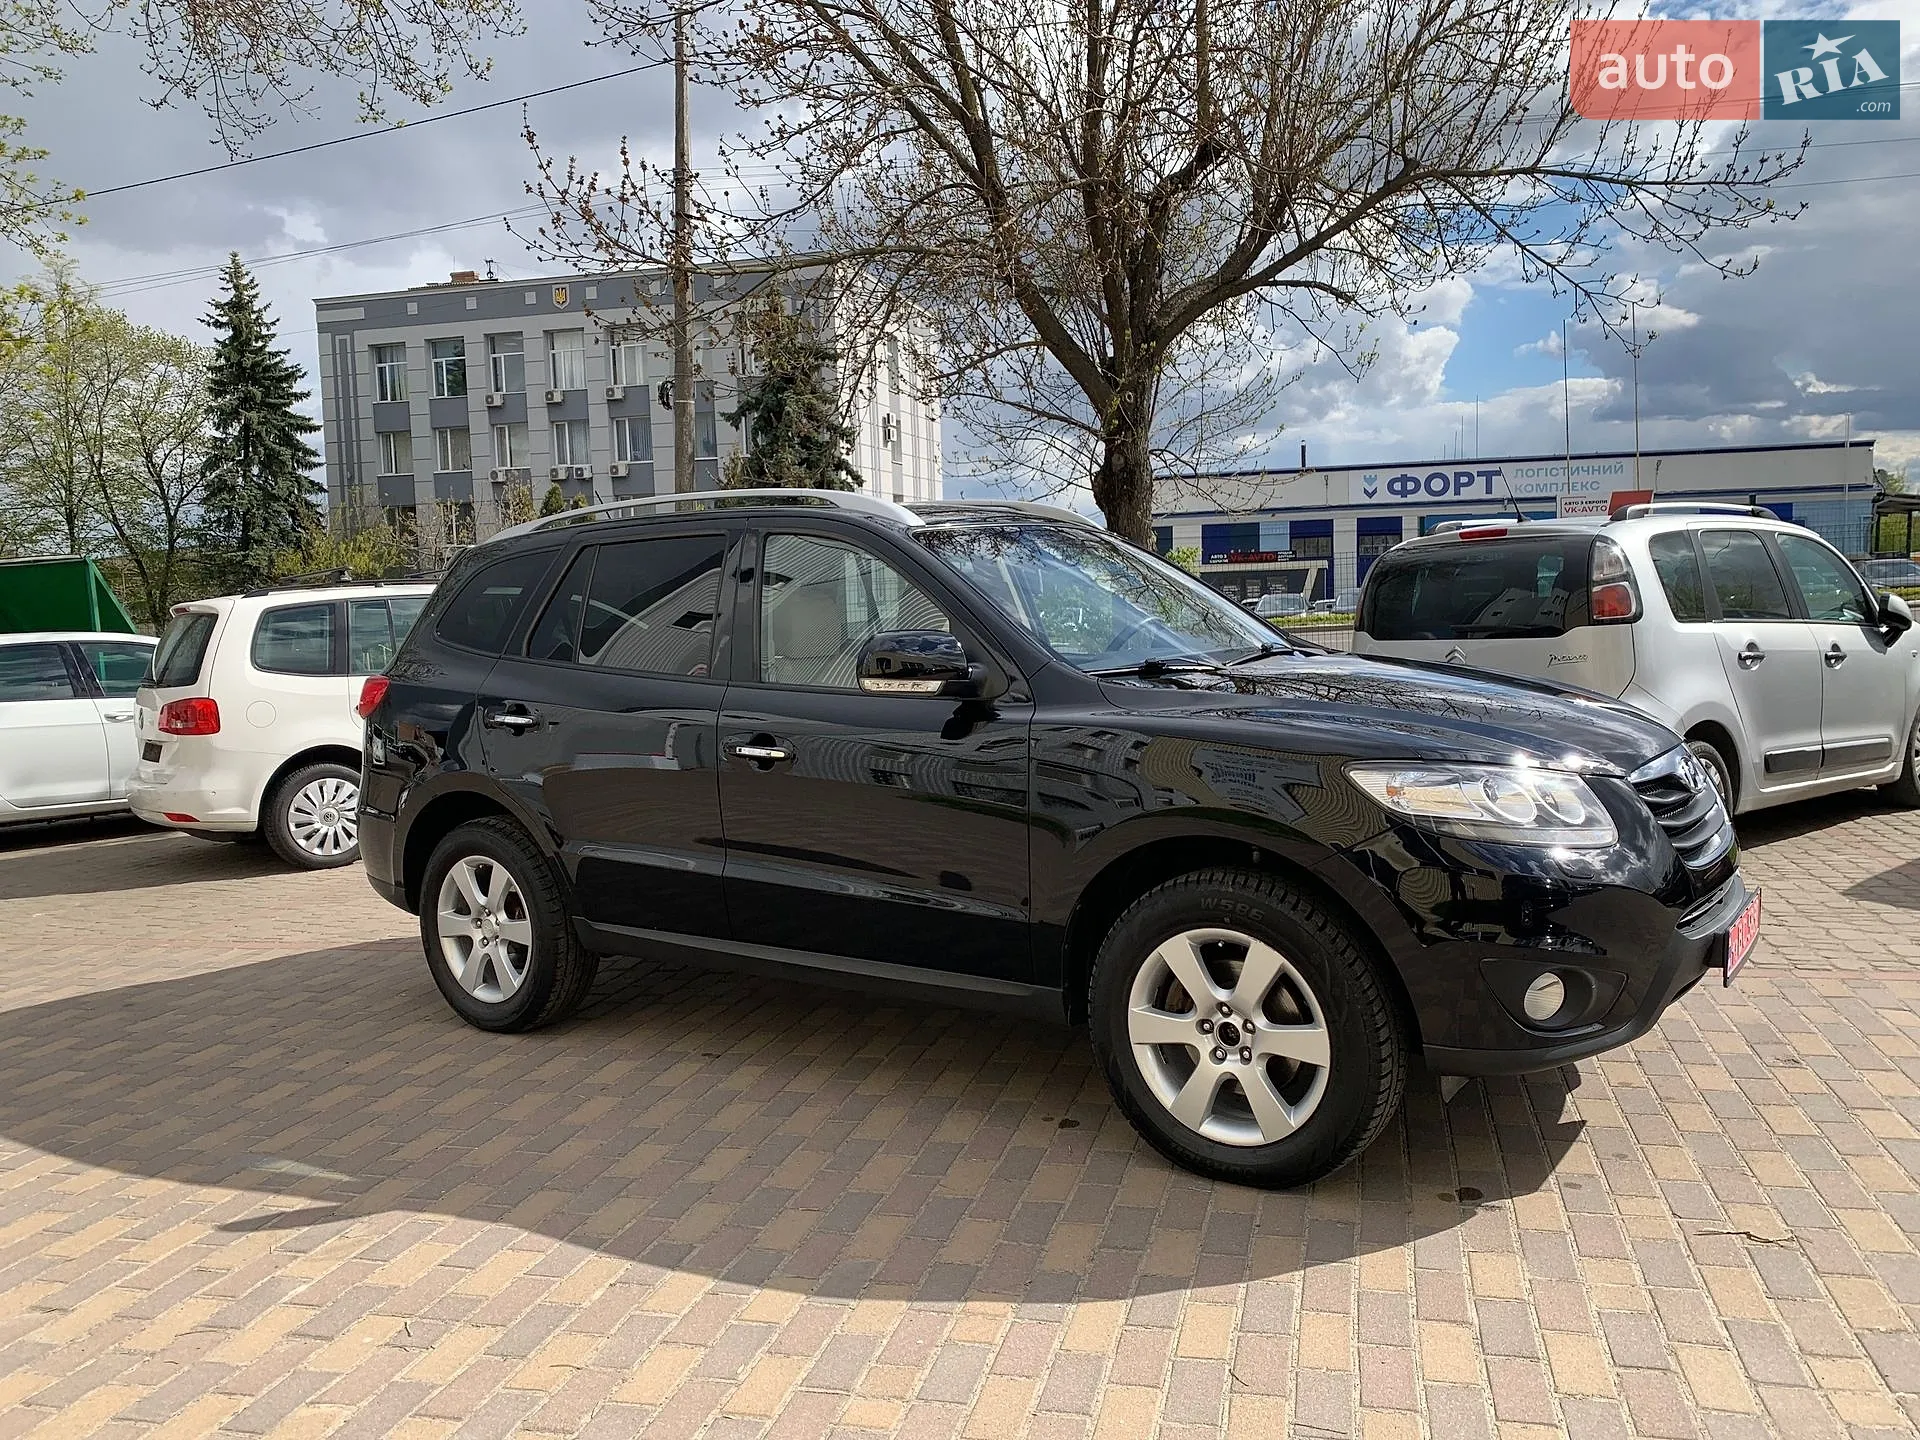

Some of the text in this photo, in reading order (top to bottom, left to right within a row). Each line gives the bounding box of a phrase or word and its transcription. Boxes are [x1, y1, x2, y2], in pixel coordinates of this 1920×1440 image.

[1513, 461, 1624, 479] ЛОГІСТИЧНИЙ
[1386, 469, 1502, 499] ФОРТ
[1513, 480, 1601, 494] КОМПЛЕКС
[1564, 505, 1608, 513] VK-AVTO
